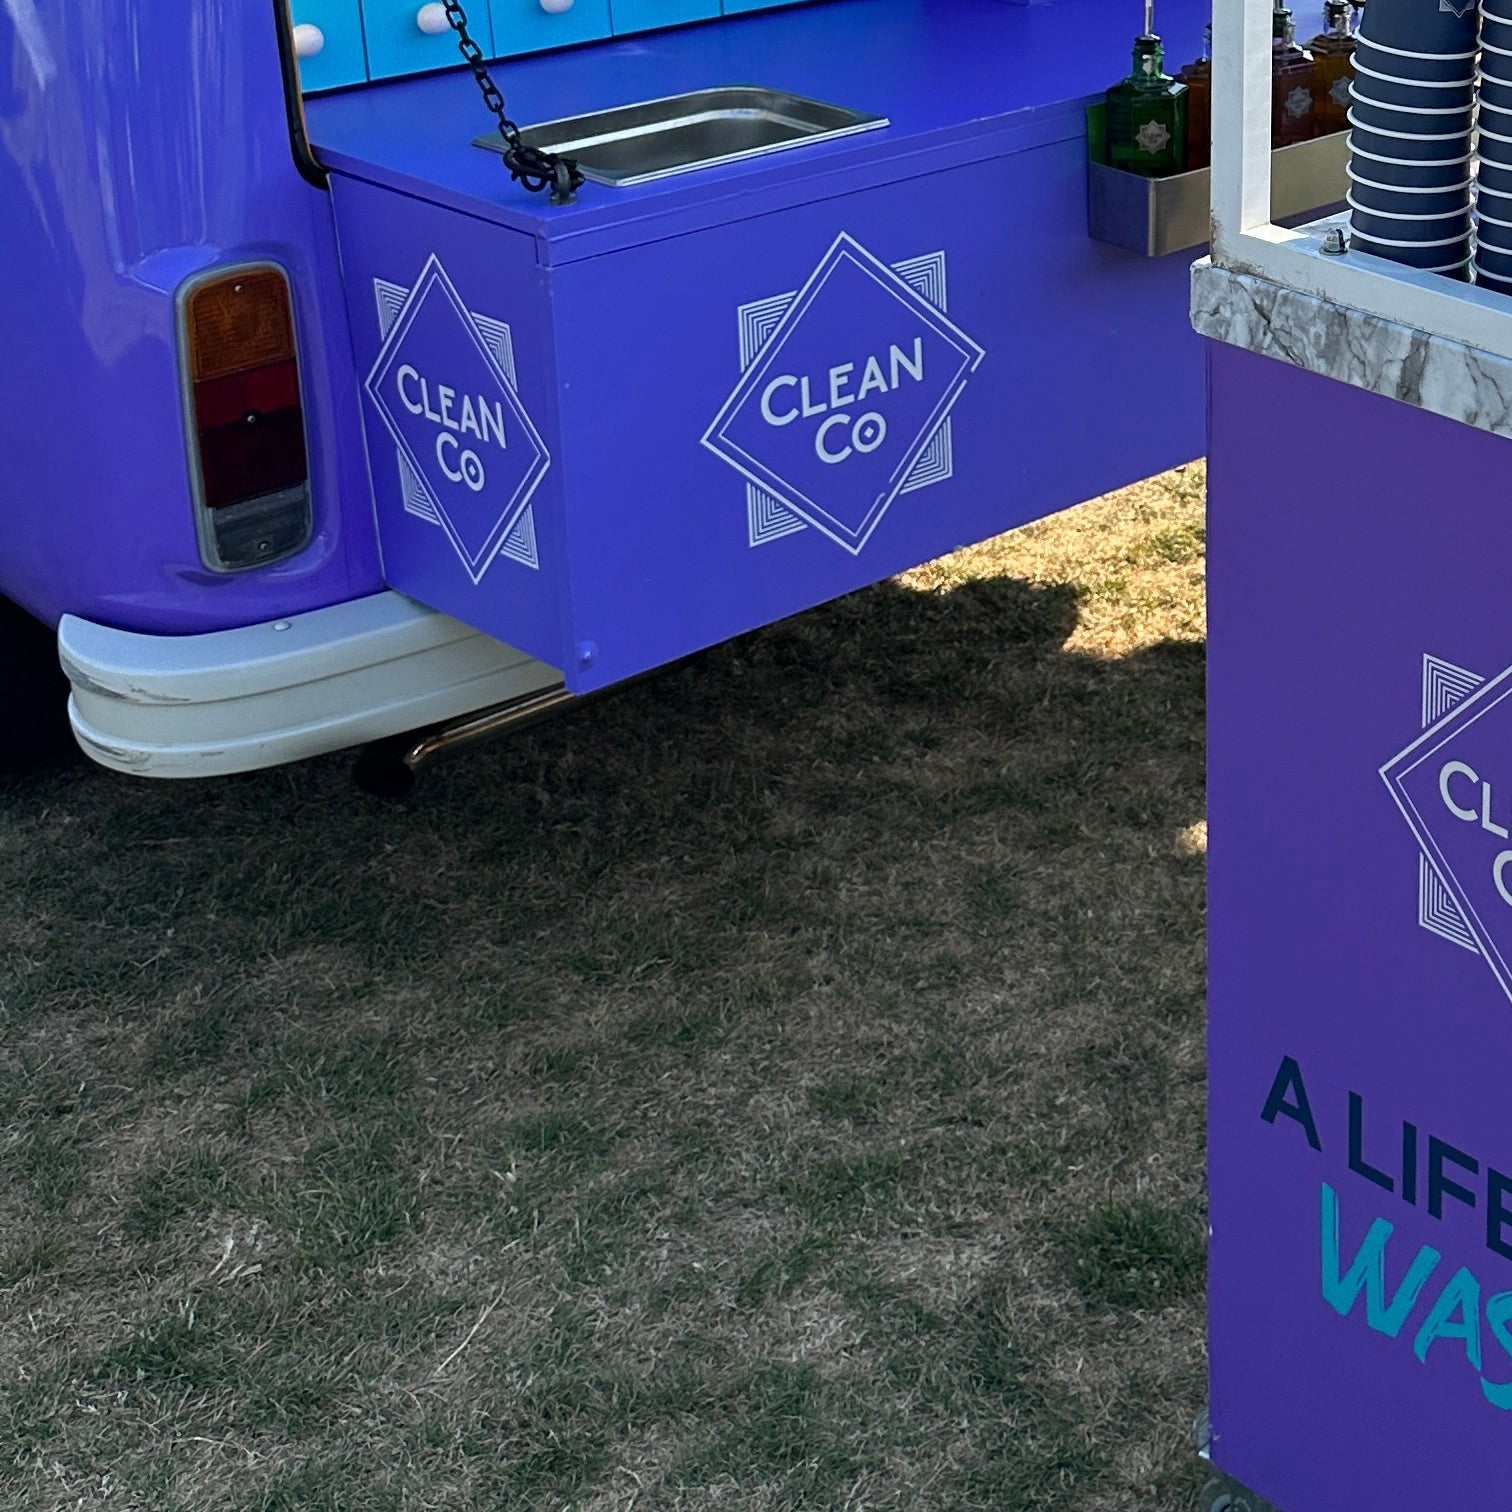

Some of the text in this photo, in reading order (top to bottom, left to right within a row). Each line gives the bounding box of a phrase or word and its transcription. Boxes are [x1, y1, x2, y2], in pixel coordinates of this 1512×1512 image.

[397, 364, 506, 449] CLEAN
[760, 337, 924, 428] CLEAN
[436, 431, 485, 491] CO
[814, 412, 887, 464] CO
[1259, 1055, 1322, 1152] A
